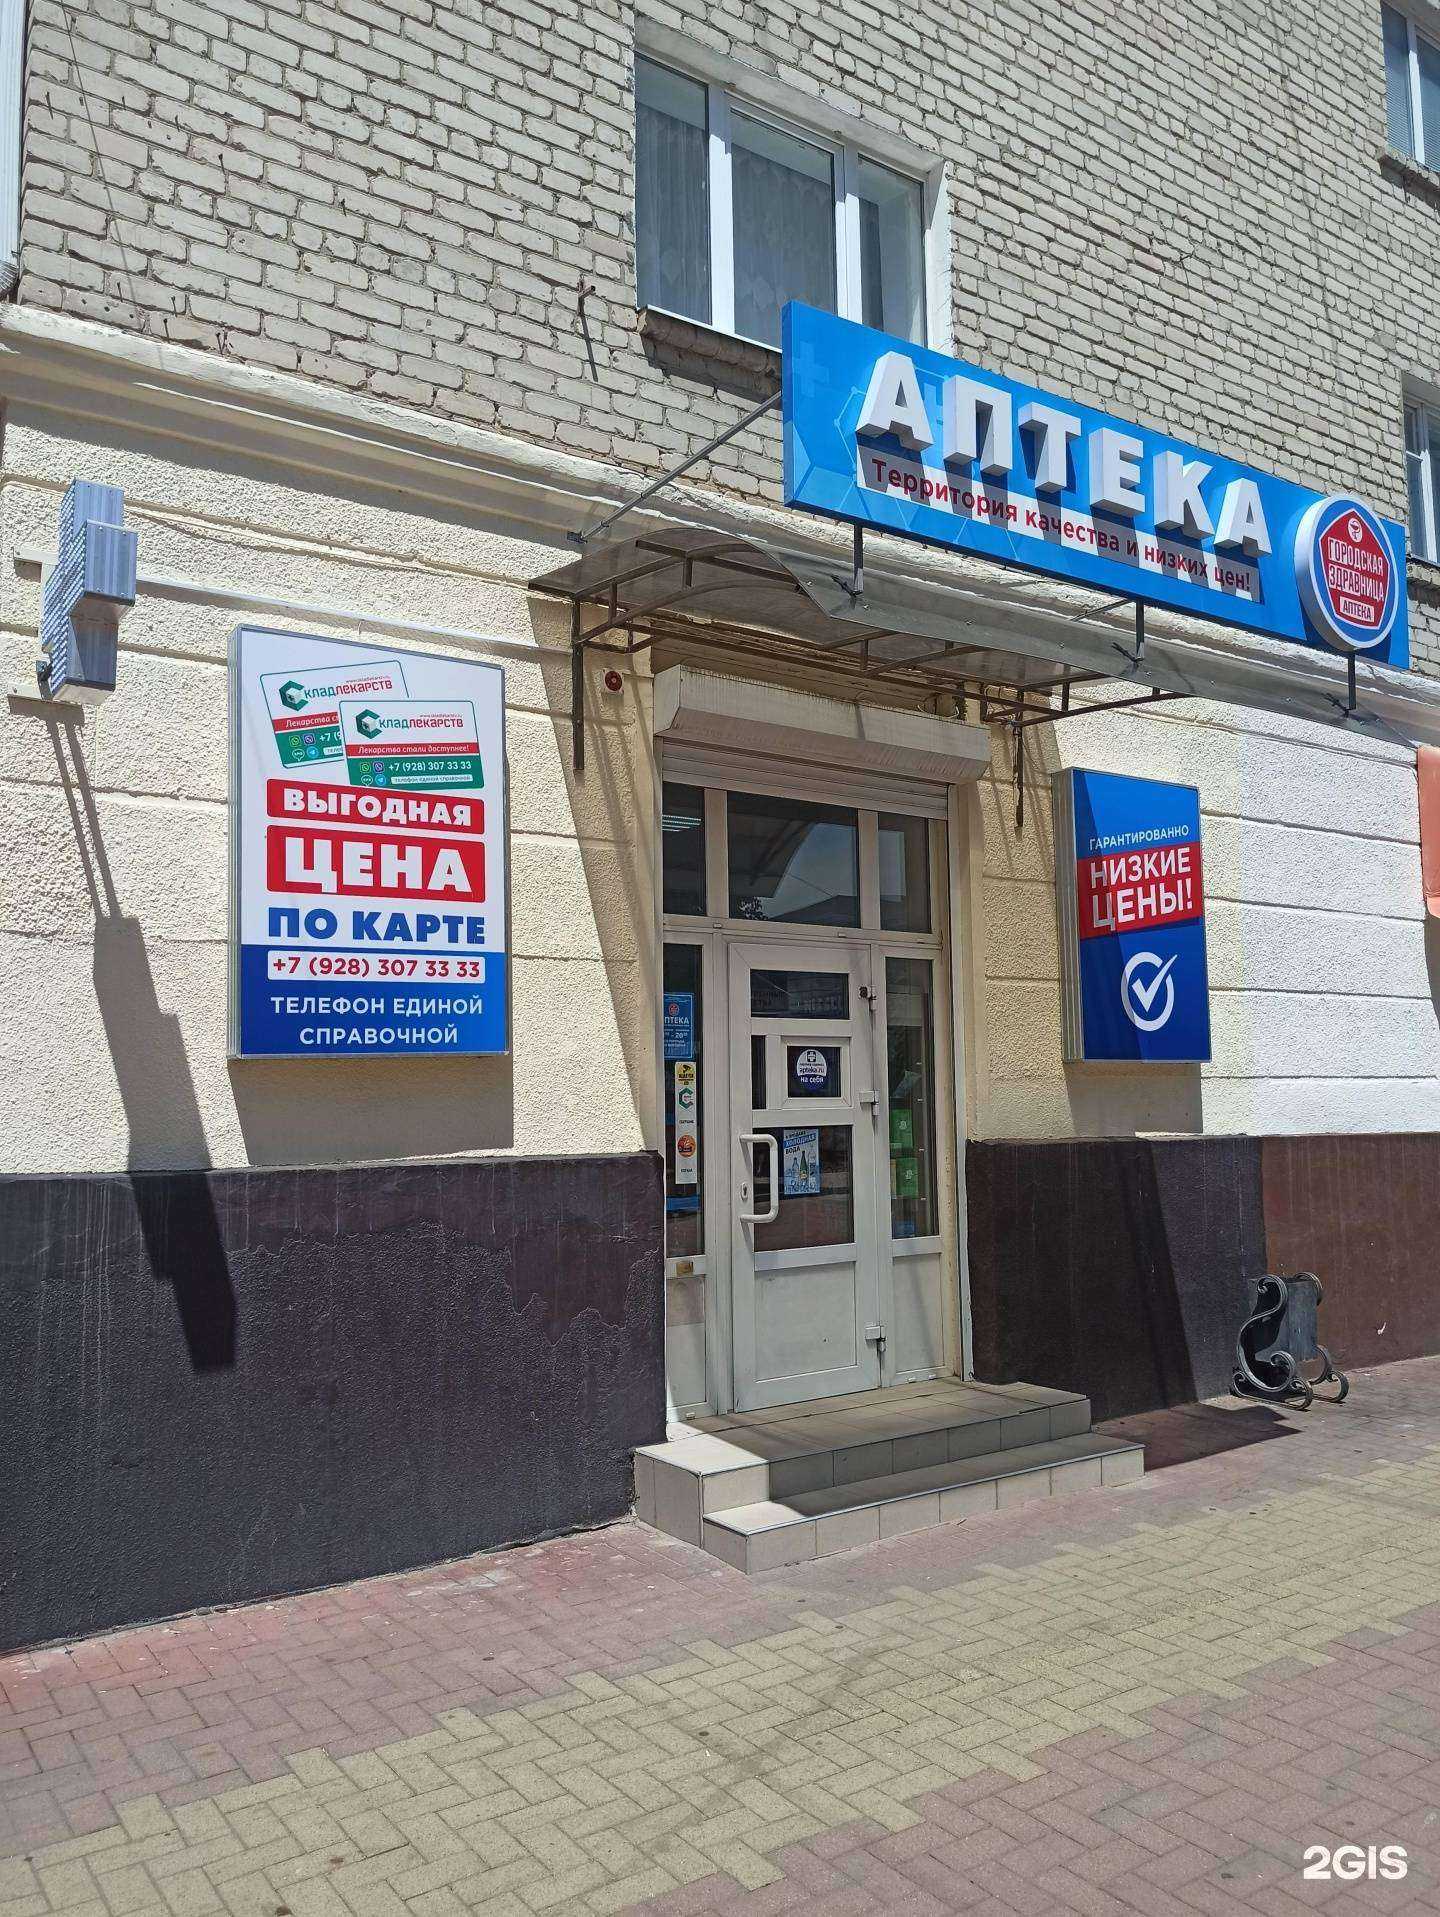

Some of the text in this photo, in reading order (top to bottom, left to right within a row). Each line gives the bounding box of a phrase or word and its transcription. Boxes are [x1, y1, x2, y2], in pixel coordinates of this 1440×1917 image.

[855, 351, 1272, 557] АПТЕКА
[871, 458, 1251, 593] Территория качества и низких цен!
[1328, 537, 1383, 577] ГОРОДСКАЯ
[1328, 563, 1385, 603] ЗДРАВНИЦА
[1342, 600, 1373, 621] АПТЕКА
[286, 717, 331, 728] Лекарство
[358, 746, 401, 755] Лекарство
[428, 745, 470, 754] доступнее!
[388, 760, 472, 772] +7 (928) 307 33 33
[283, 788, 472, 827] ВЫГОДНАЯ
[1089, 825, 1190, 850] ГАРАНТИРОВАННО
[285, 837, 473, 893] ЦЕНА
[1091, 846, 1191, 889] НИЗКИЕ
[1092, 878, 1193, 931] ЦЕНЫ!
[268, 907, 485, 945] ПО КАРТЕ
[273, 956, 480, 978] +7 (928) 307 33 33
[271, 995, 483, 1018] ТЕЛЕФОН ЕДИНОЙ
[664, 1016, 690, 1025] ПТЕКА
[299, 1023, 459, 1045] СПРАВОЧНОЙ
